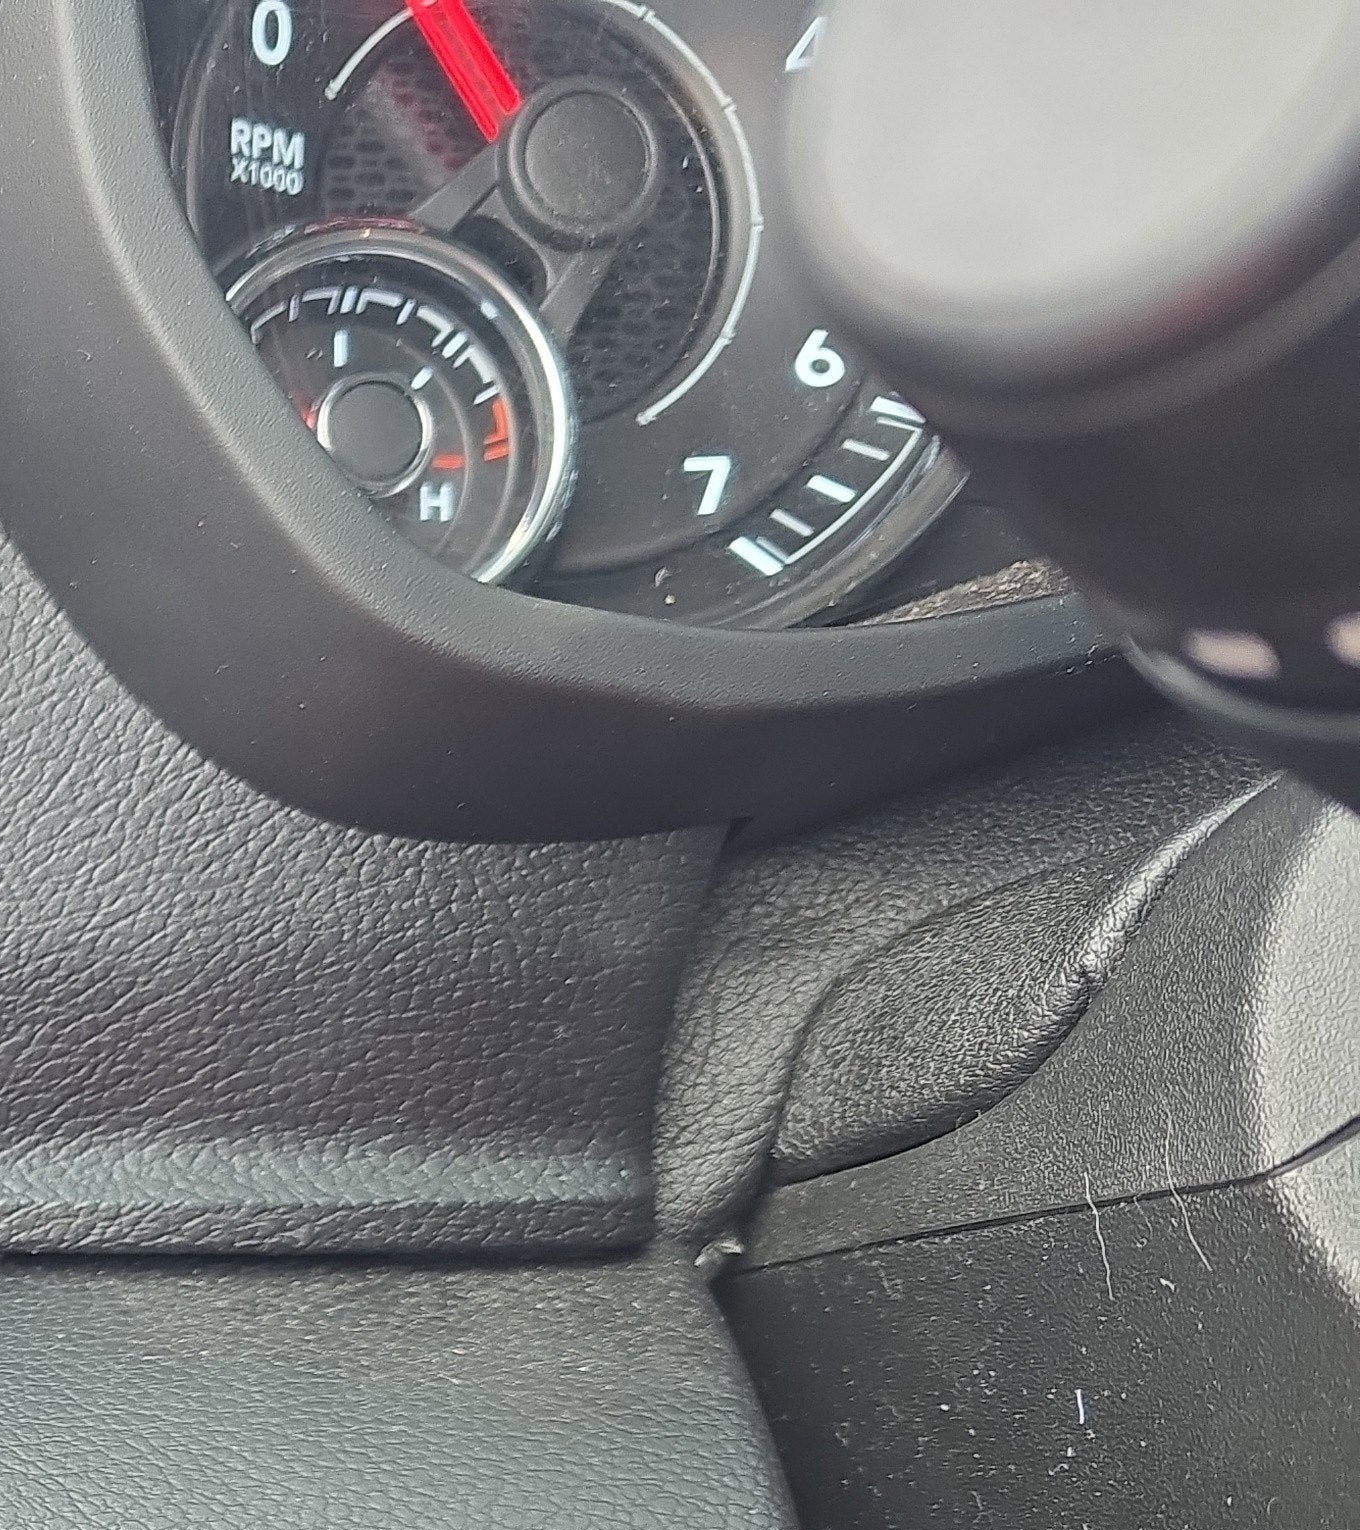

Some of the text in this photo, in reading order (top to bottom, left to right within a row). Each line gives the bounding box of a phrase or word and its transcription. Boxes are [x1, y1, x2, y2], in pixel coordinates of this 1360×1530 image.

[251, 0, 293, 66] 0
[230, 117, 305, 170] RPM
[230, 156, 304, 196] X1000
[794, 329, 846, 388] 6
[419, 481, 456, 522] H
[683, 455, 731, 516] 7
